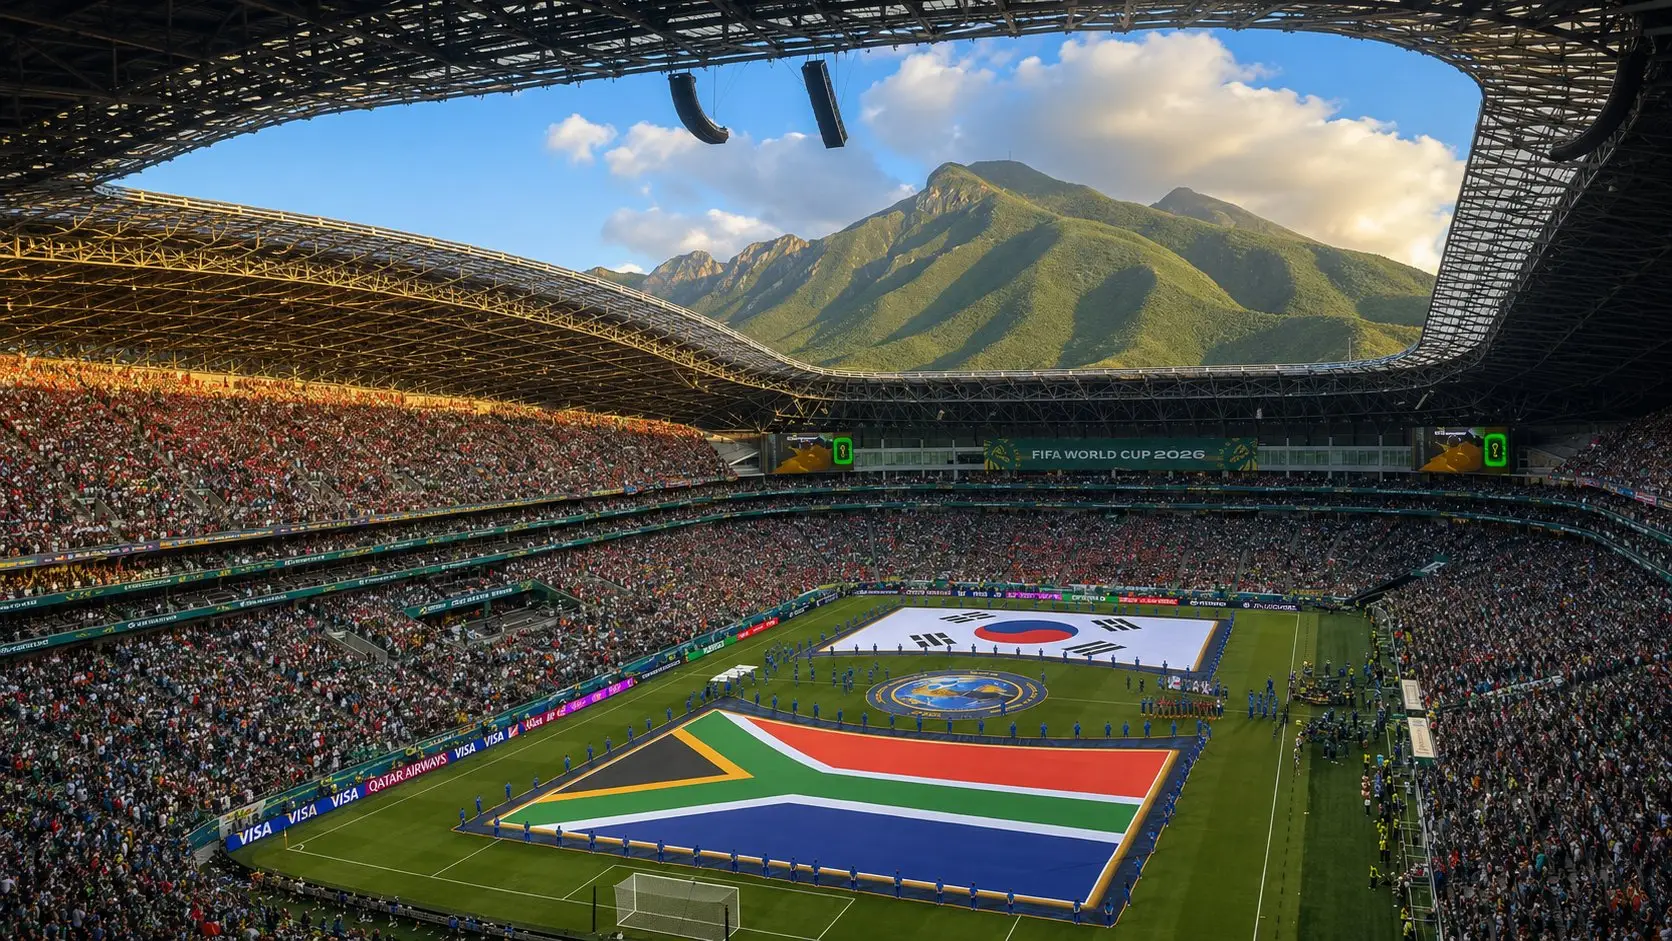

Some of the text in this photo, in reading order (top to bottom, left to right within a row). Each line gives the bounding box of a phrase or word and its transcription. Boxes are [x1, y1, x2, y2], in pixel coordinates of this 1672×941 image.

[1032, 450, 1206, 460] FIFA WORLD CUP 2026
[483, 731, 504, 747] VISA
[454, 742, 476, 759] VISA
[368, 752, 447, 792] QATAR AIRWAYS
[331, 787, 359, 808] VISA
[287, 803, 318, 824] VISA
[239, 821, 273, 845] VISA
